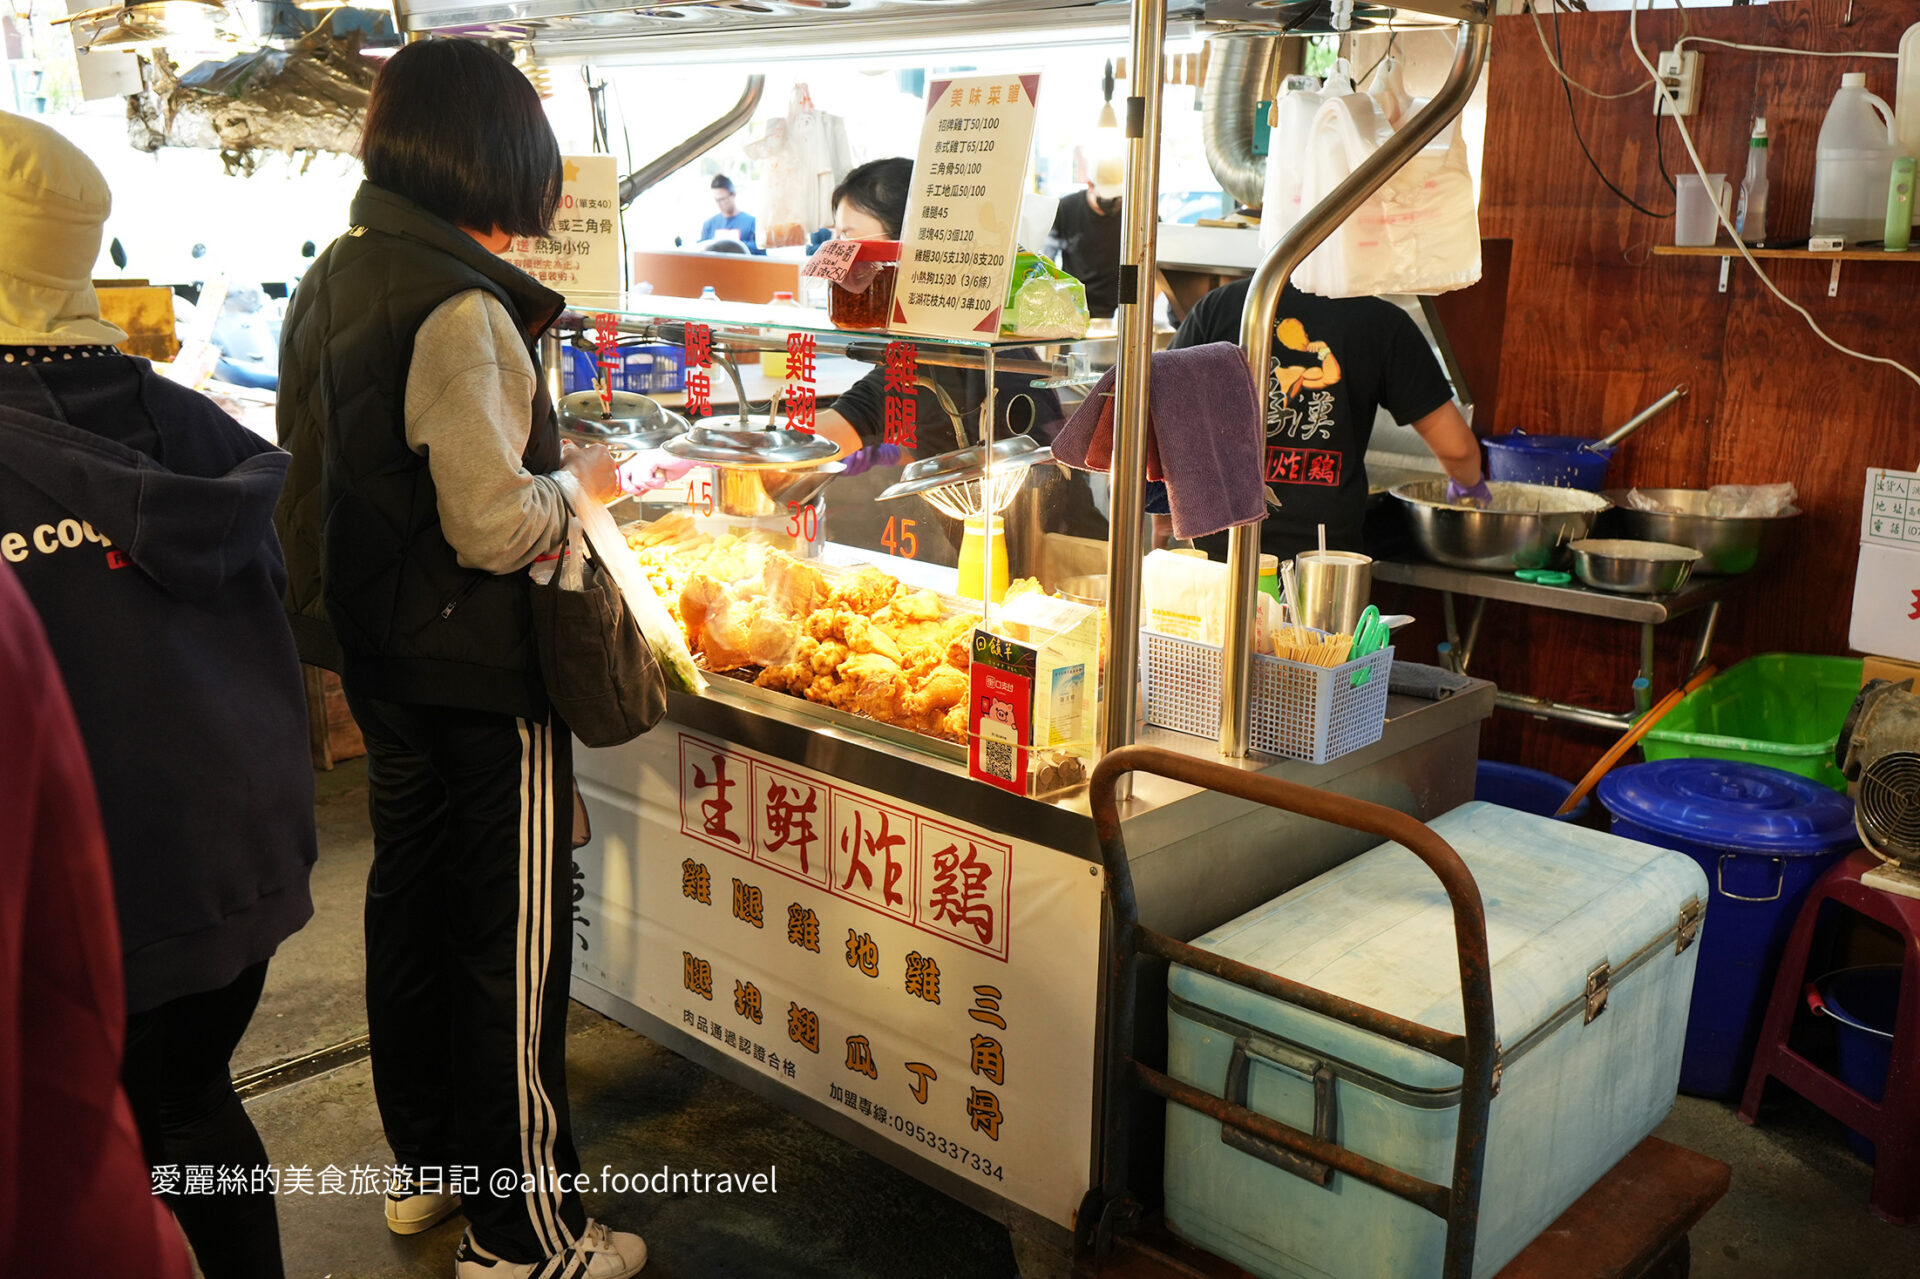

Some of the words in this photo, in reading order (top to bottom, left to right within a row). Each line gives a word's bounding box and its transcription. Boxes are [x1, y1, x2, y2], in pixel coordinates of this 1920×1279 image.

[950, 83, 1020, 108] 美味菜單
[938, 118, 1000, 132] 招牌雞丁50/100
[935, 140, 995, 154] 泰式雞丁65/120
[930, 162, 982, 176] 三角骨50/100
[926, 184, 986, 198] 手工地瓜50/100
[921, 205, 949, 219] 雞腿45
[535, 240, 591, 256] 熱狗小份
[914, 249, 1004, 267] 雞翅30/5支130/8支200
[595, 313, 620, 402] 雞丁
[684, 322, 713, 417] 腿塊
[785, 332, 817, 435] 雞翅
[884, 342, 918, 449] 雞腿
[686, 480, 713, 517] 45
[786, 500, 817, 543] 30
[881, 516, 918, 559] 45
[683, 1009, 796, 1079] 肉品通過認證合格
